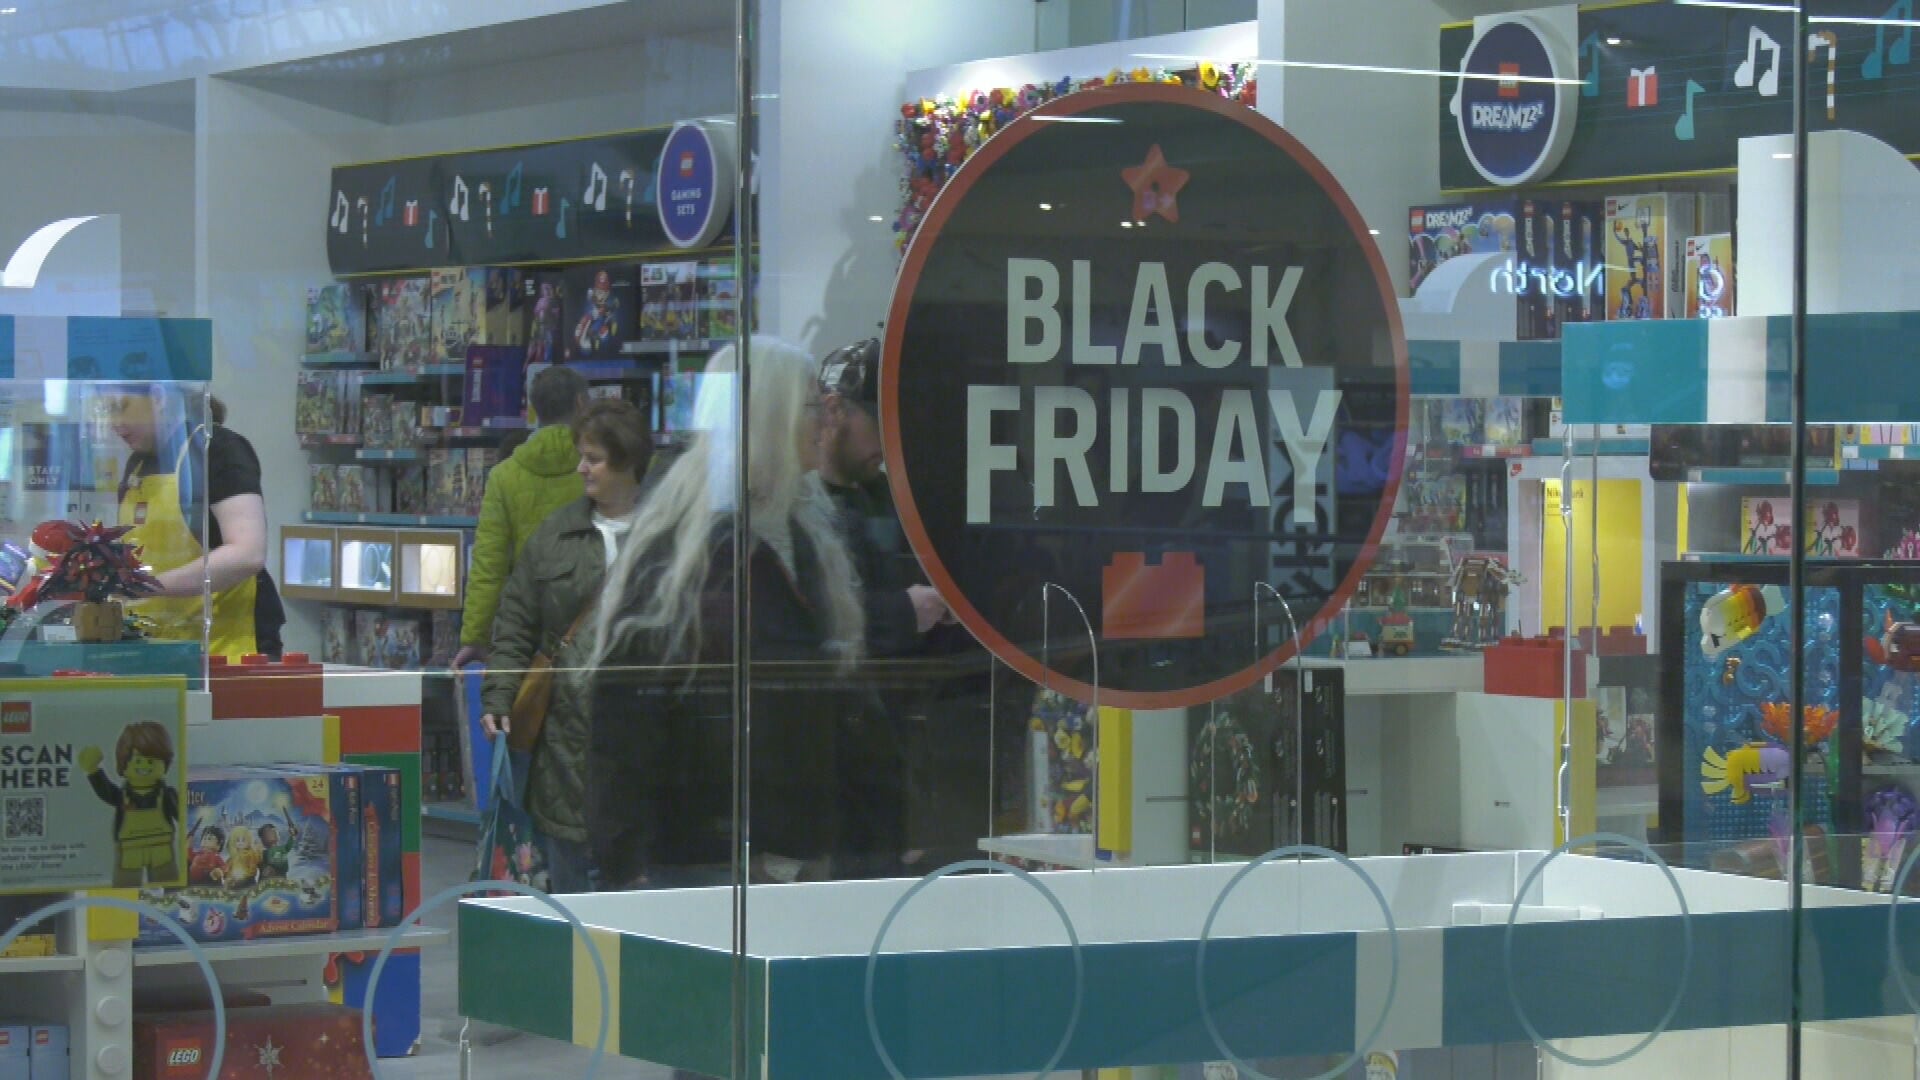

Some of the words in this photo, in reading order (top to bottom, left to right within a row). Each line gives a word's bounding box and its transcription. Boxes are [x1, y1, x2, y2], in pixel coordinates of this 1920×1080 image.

[671, 188, 702, 200] GAMING
[677, 203, 696, 216] SETS
[1007, 257, 1304, 369] BLACK
[966, 384, 1344, 525] FRIDAY
[1, 744, 73, 767] SCAN
[1, 767, 71, 788] HERE
[168, 1049, 200, 1065] LEGO
